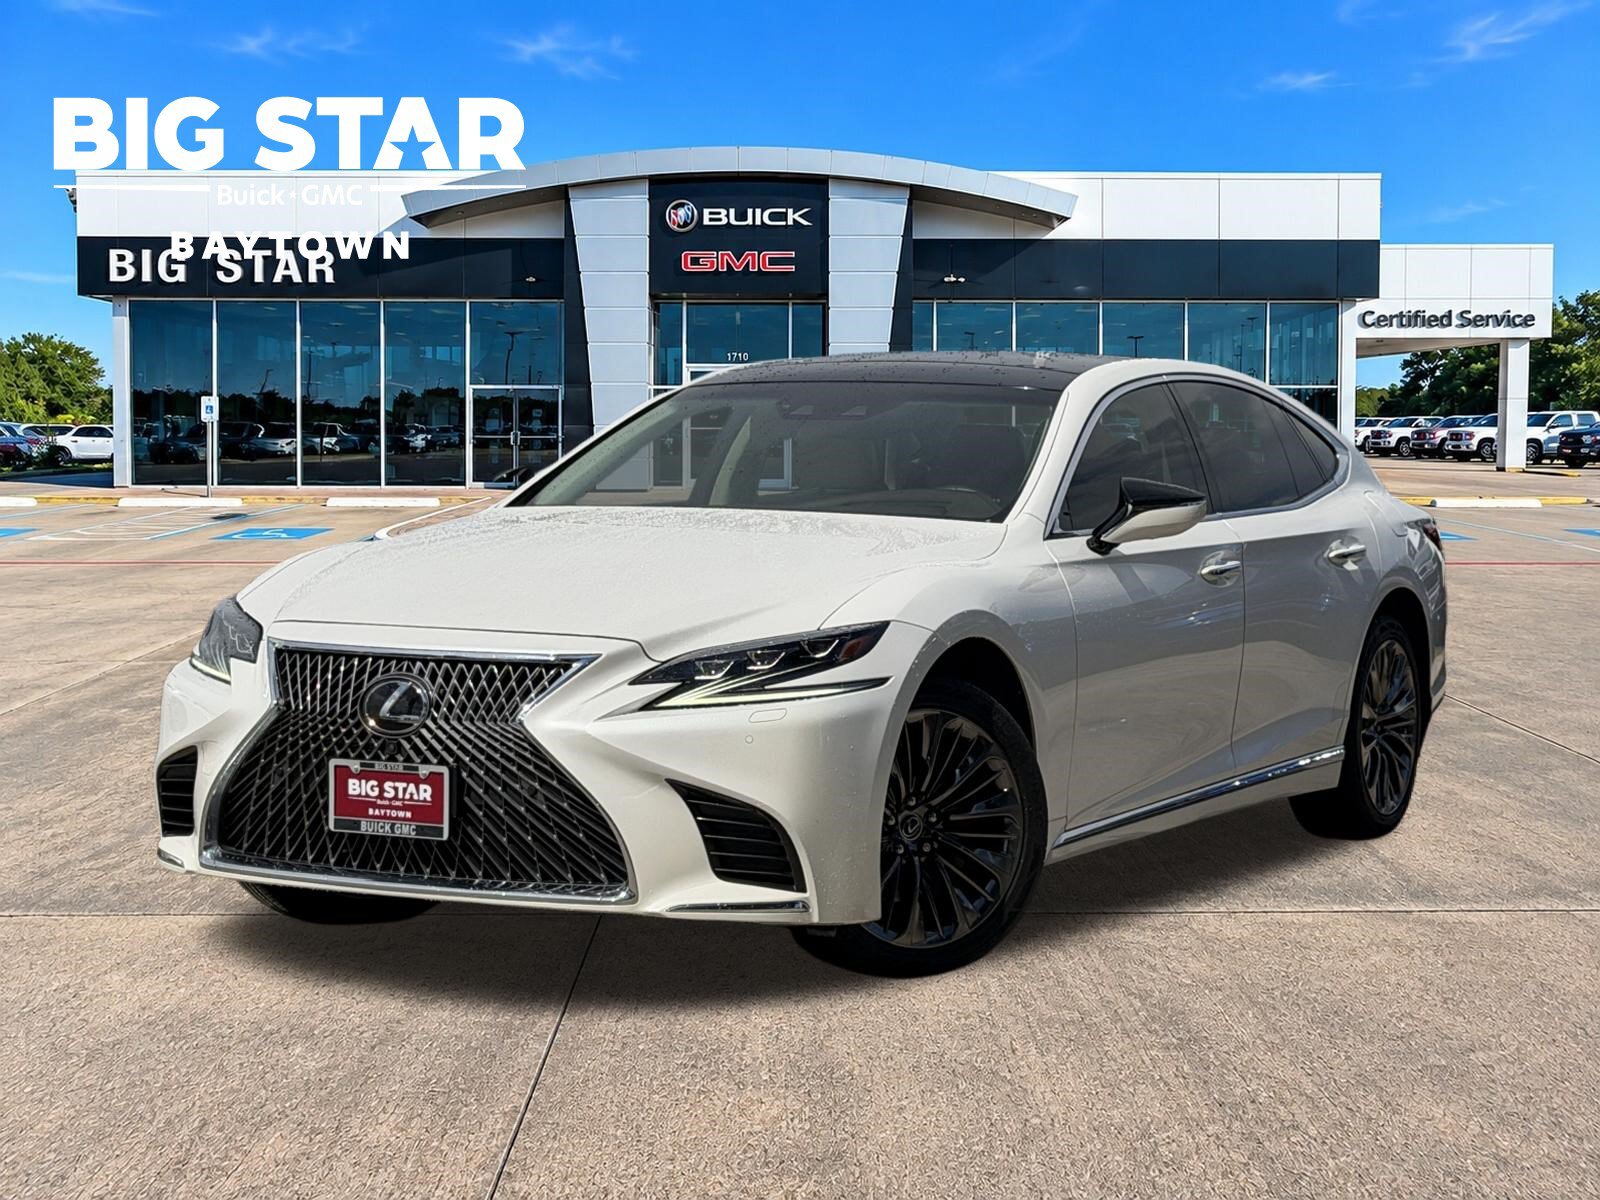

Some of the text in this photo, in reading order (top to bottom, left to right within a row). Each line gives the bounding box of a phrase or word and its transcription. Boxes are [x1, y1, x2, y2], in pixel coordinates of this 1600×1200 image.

[702, 207, 813, 226] BUICK
[108, 249, 336, 283] BIG STAR
[681, 250, 796, 272] GMC
[1361, 309, 1536, 328] Certified Service
[727, 352, 749, 362] 1710
[347, 778, 433, 802] BIG STAR
[368, 807, 412, 819] BAYTOWN
[360, 820, 417, 836] BUICK GMC
